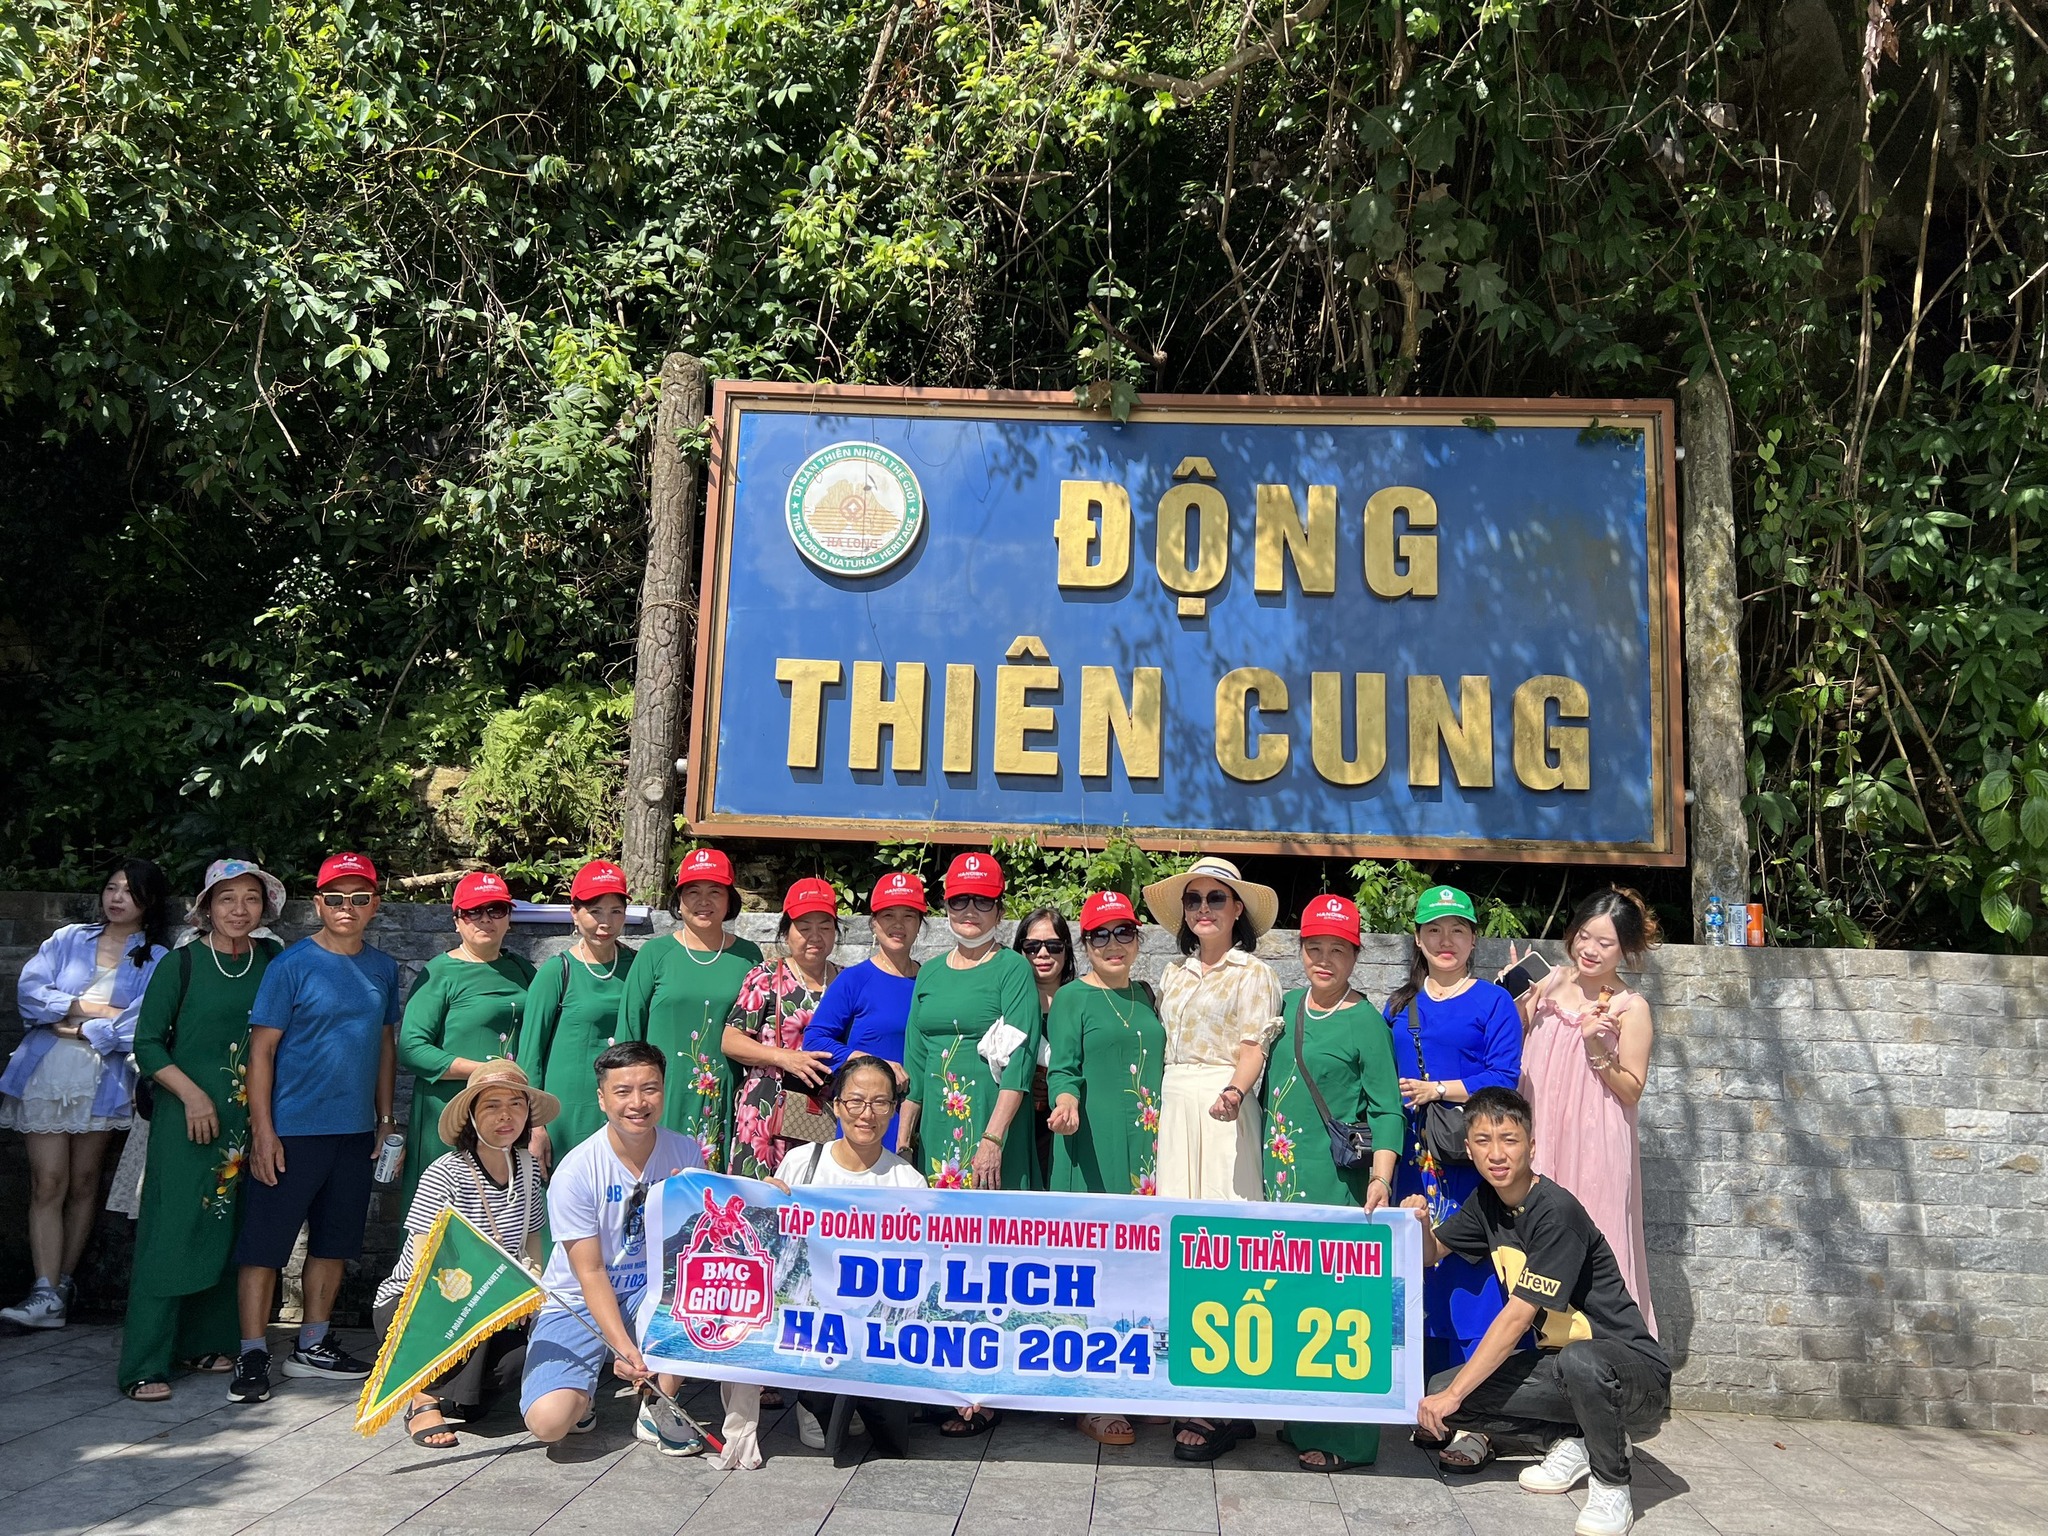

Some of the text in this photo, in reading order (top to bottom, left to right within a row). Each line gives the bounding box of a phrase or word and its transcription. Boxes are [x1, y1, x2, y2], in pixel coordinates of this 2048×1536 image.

[793, 484, 804, 497] DI
[817, 448, 851, 466] THIÊN
[853, 448, 889, 465] NHIÊN
[888, 461, 908, 479] THẾ
[902, 480, 916, 503] GIỚI
[791, 513, 916, 568] THE WORLD NATURAL HERITAGE
[846, 538, 878, 548] LONG
[1054, 456, 1438, 618] ĐỘNG
[776, 635, 1591, 791] THIÊN CUNG
[779, 1203, 1161, 1252] TẬP ĐOÀN ĐỨC HẠNH MARPHAVET BMG
[1180, 1228, 1382, 1282] TÀU THĂM VỊNH
[702, 1262, 752, 1281] BMG
[837, 1255, 1096, 1316] DU LỊCH
[1519, 1271, 1558, 1294] drew
[689, 1286, 760, 1314] GROUP
[779, 1309, 1151, 1375] HẠ LONG 2024
[1190, 1279, 1372, 1380] SỐ 23
